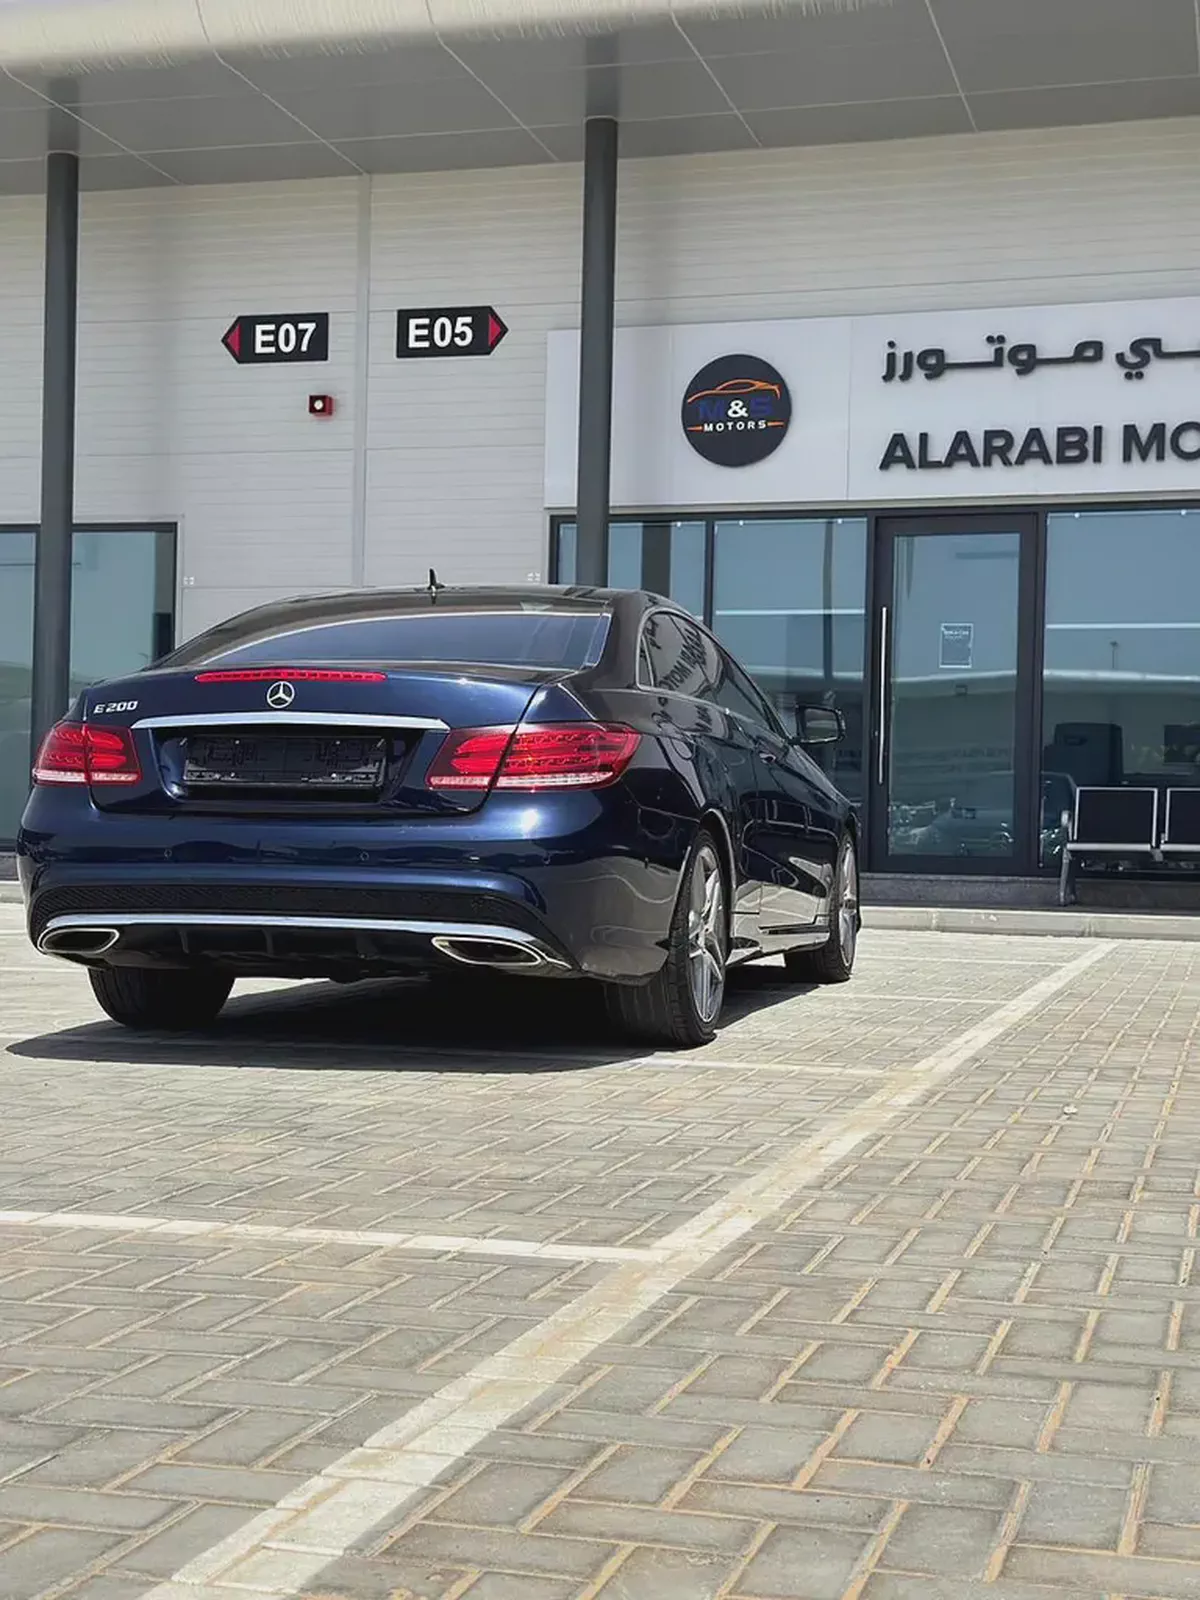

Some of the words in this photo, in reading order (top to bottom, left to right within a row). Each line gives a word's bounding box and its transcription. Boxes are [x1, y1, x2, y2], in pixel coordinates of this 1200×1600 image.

[254, 322, 317, 354] E07
[407, 315, 474, 348] E05
[881, 334, 1104, 382] موتورز
[703, 419, 767, 433] MOTORS
[878, 424, 1104, 471] ALARABI
